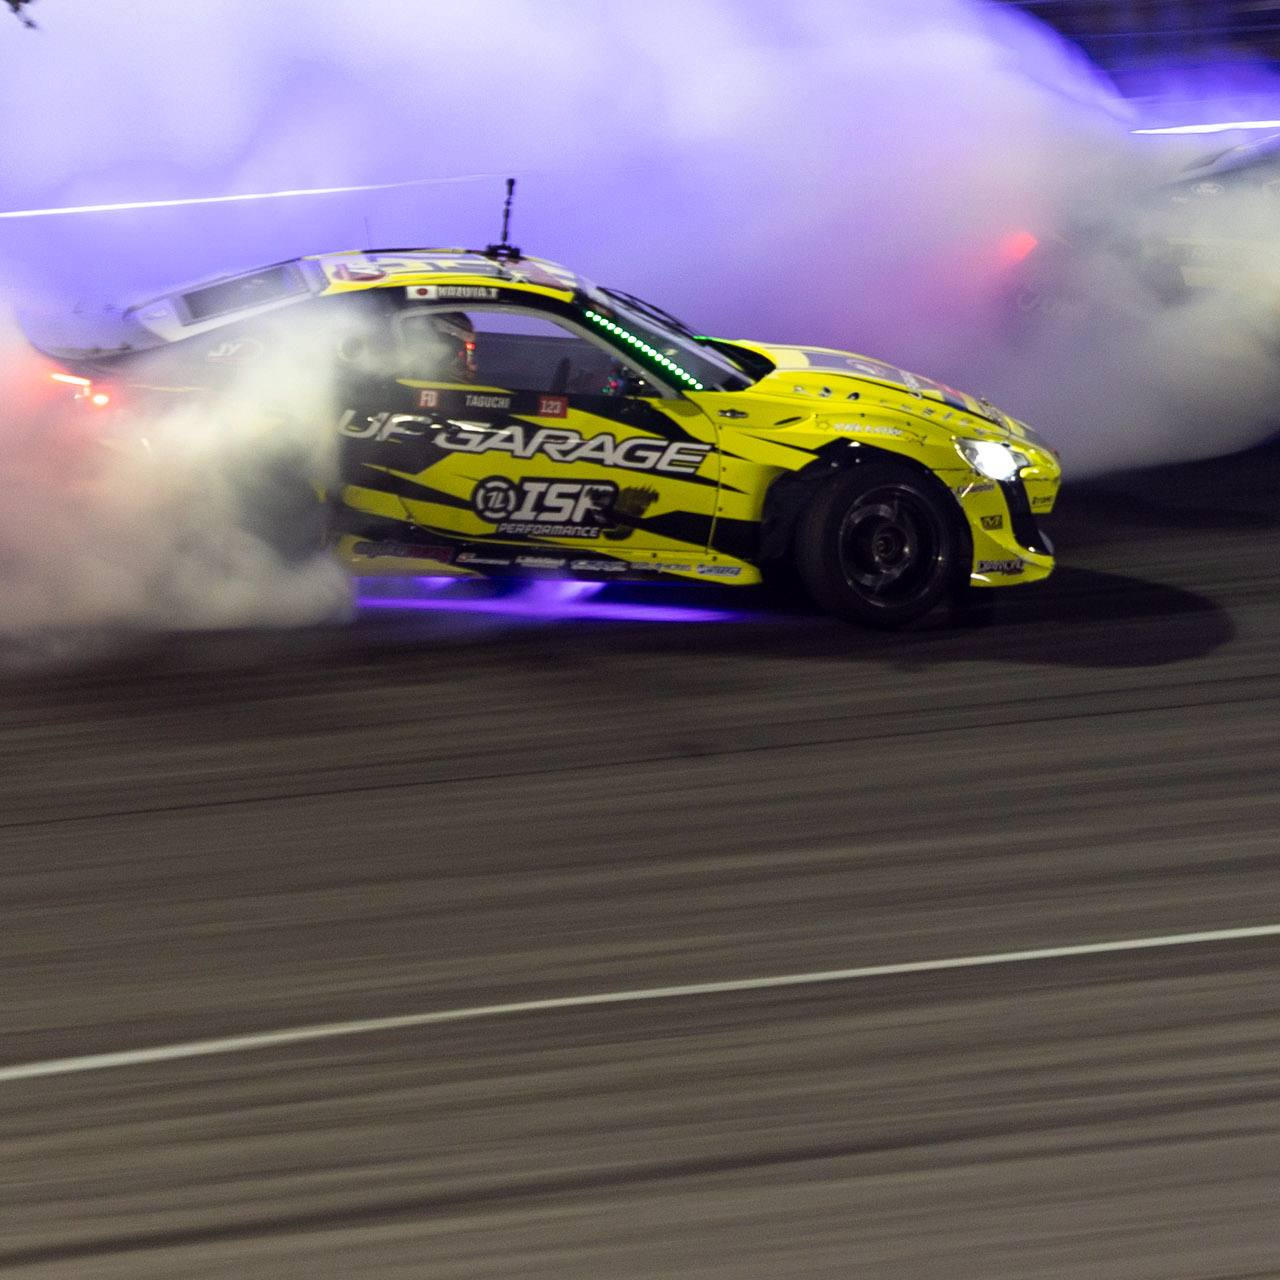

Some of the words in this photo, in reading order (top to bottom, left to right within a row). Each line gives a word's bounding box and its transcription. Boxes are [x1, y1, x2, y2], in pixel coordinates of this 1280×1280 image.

[465, 395, 511, 408] TAGUCHI
[541, 400, 562, 414] 123
[433, 420, 711, 474] GARAGE
[498, 523, 600, 537] PERFORMANCE
